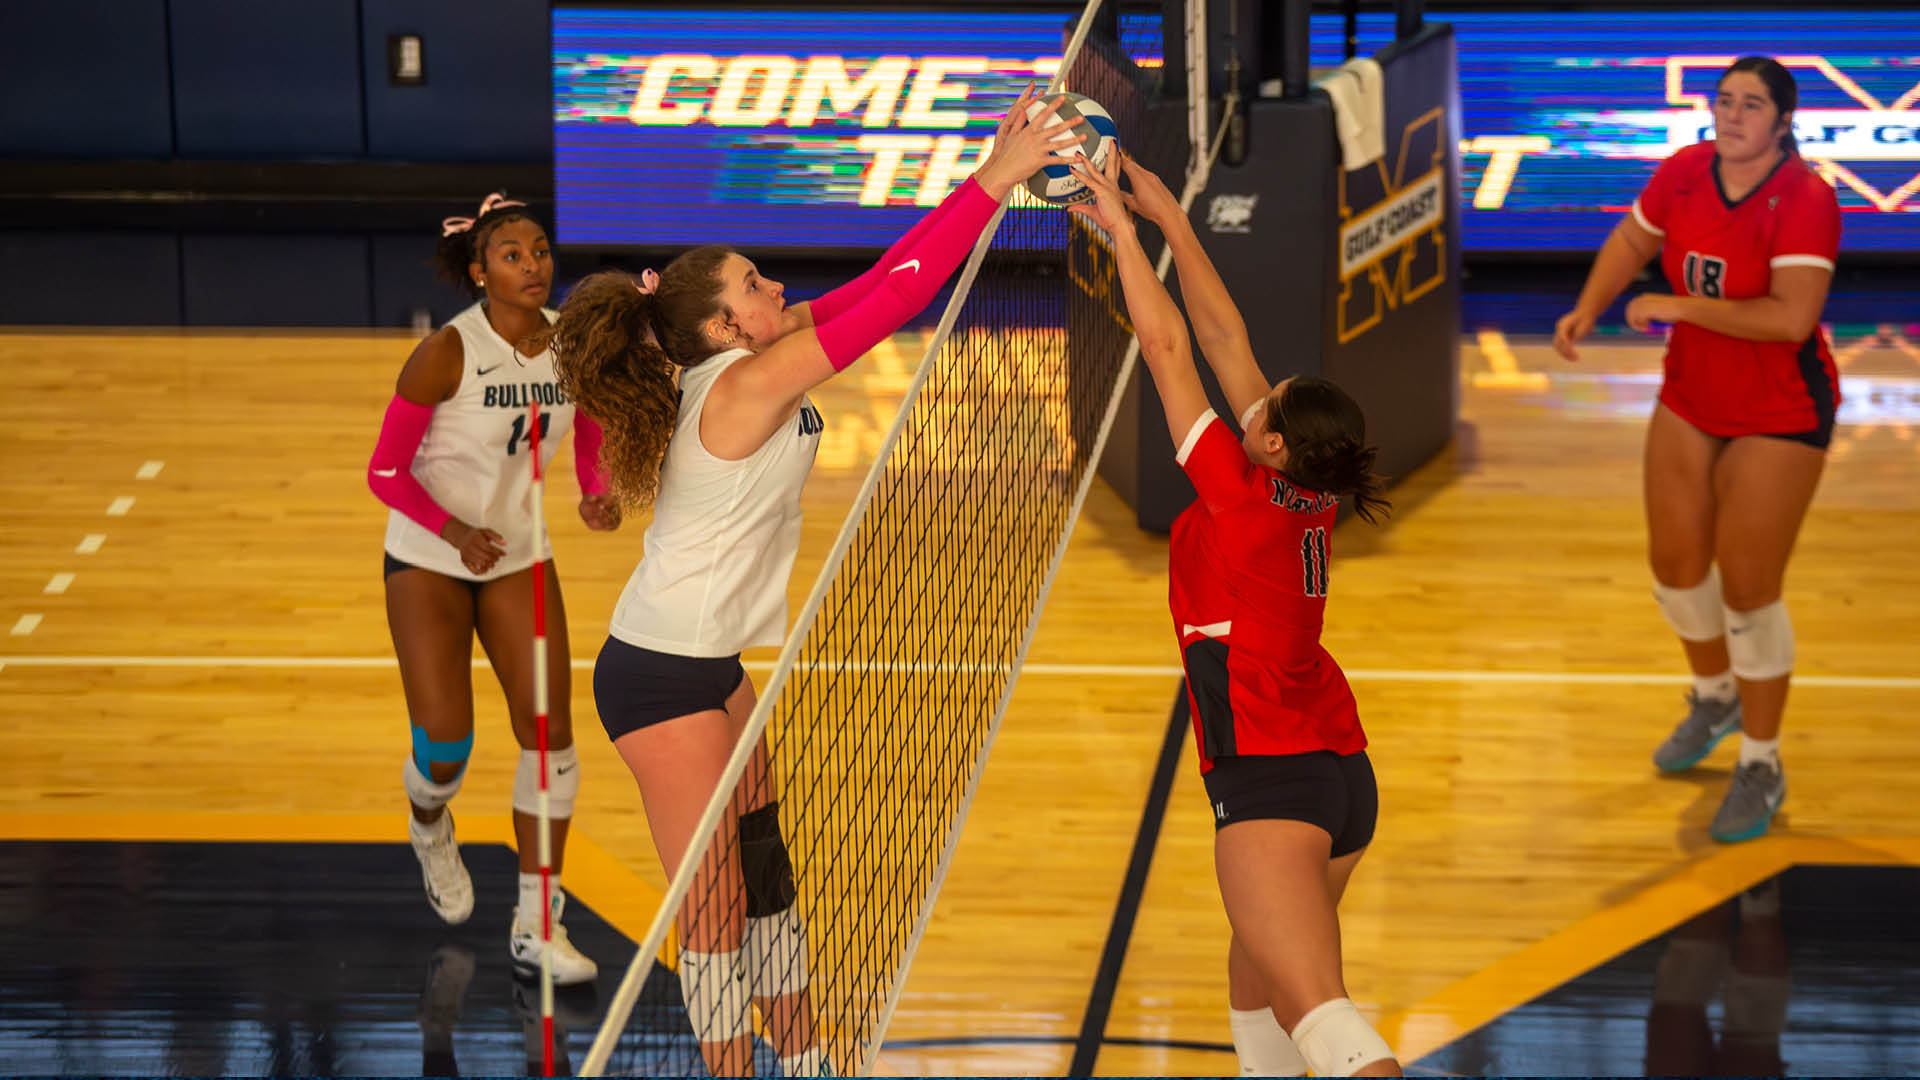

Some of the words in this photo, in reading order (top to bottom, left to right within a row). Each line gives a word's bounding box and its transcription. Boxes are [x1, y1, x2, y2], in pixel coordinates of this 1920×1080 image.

[628, 54, 989, 128] COME
[1345, 216, 1385, 262] GULF
[1386, 185, 1438, 237] COAST
[1683, 251, 1728, 299] 18
[1301, 526, 1329, 598] 11
